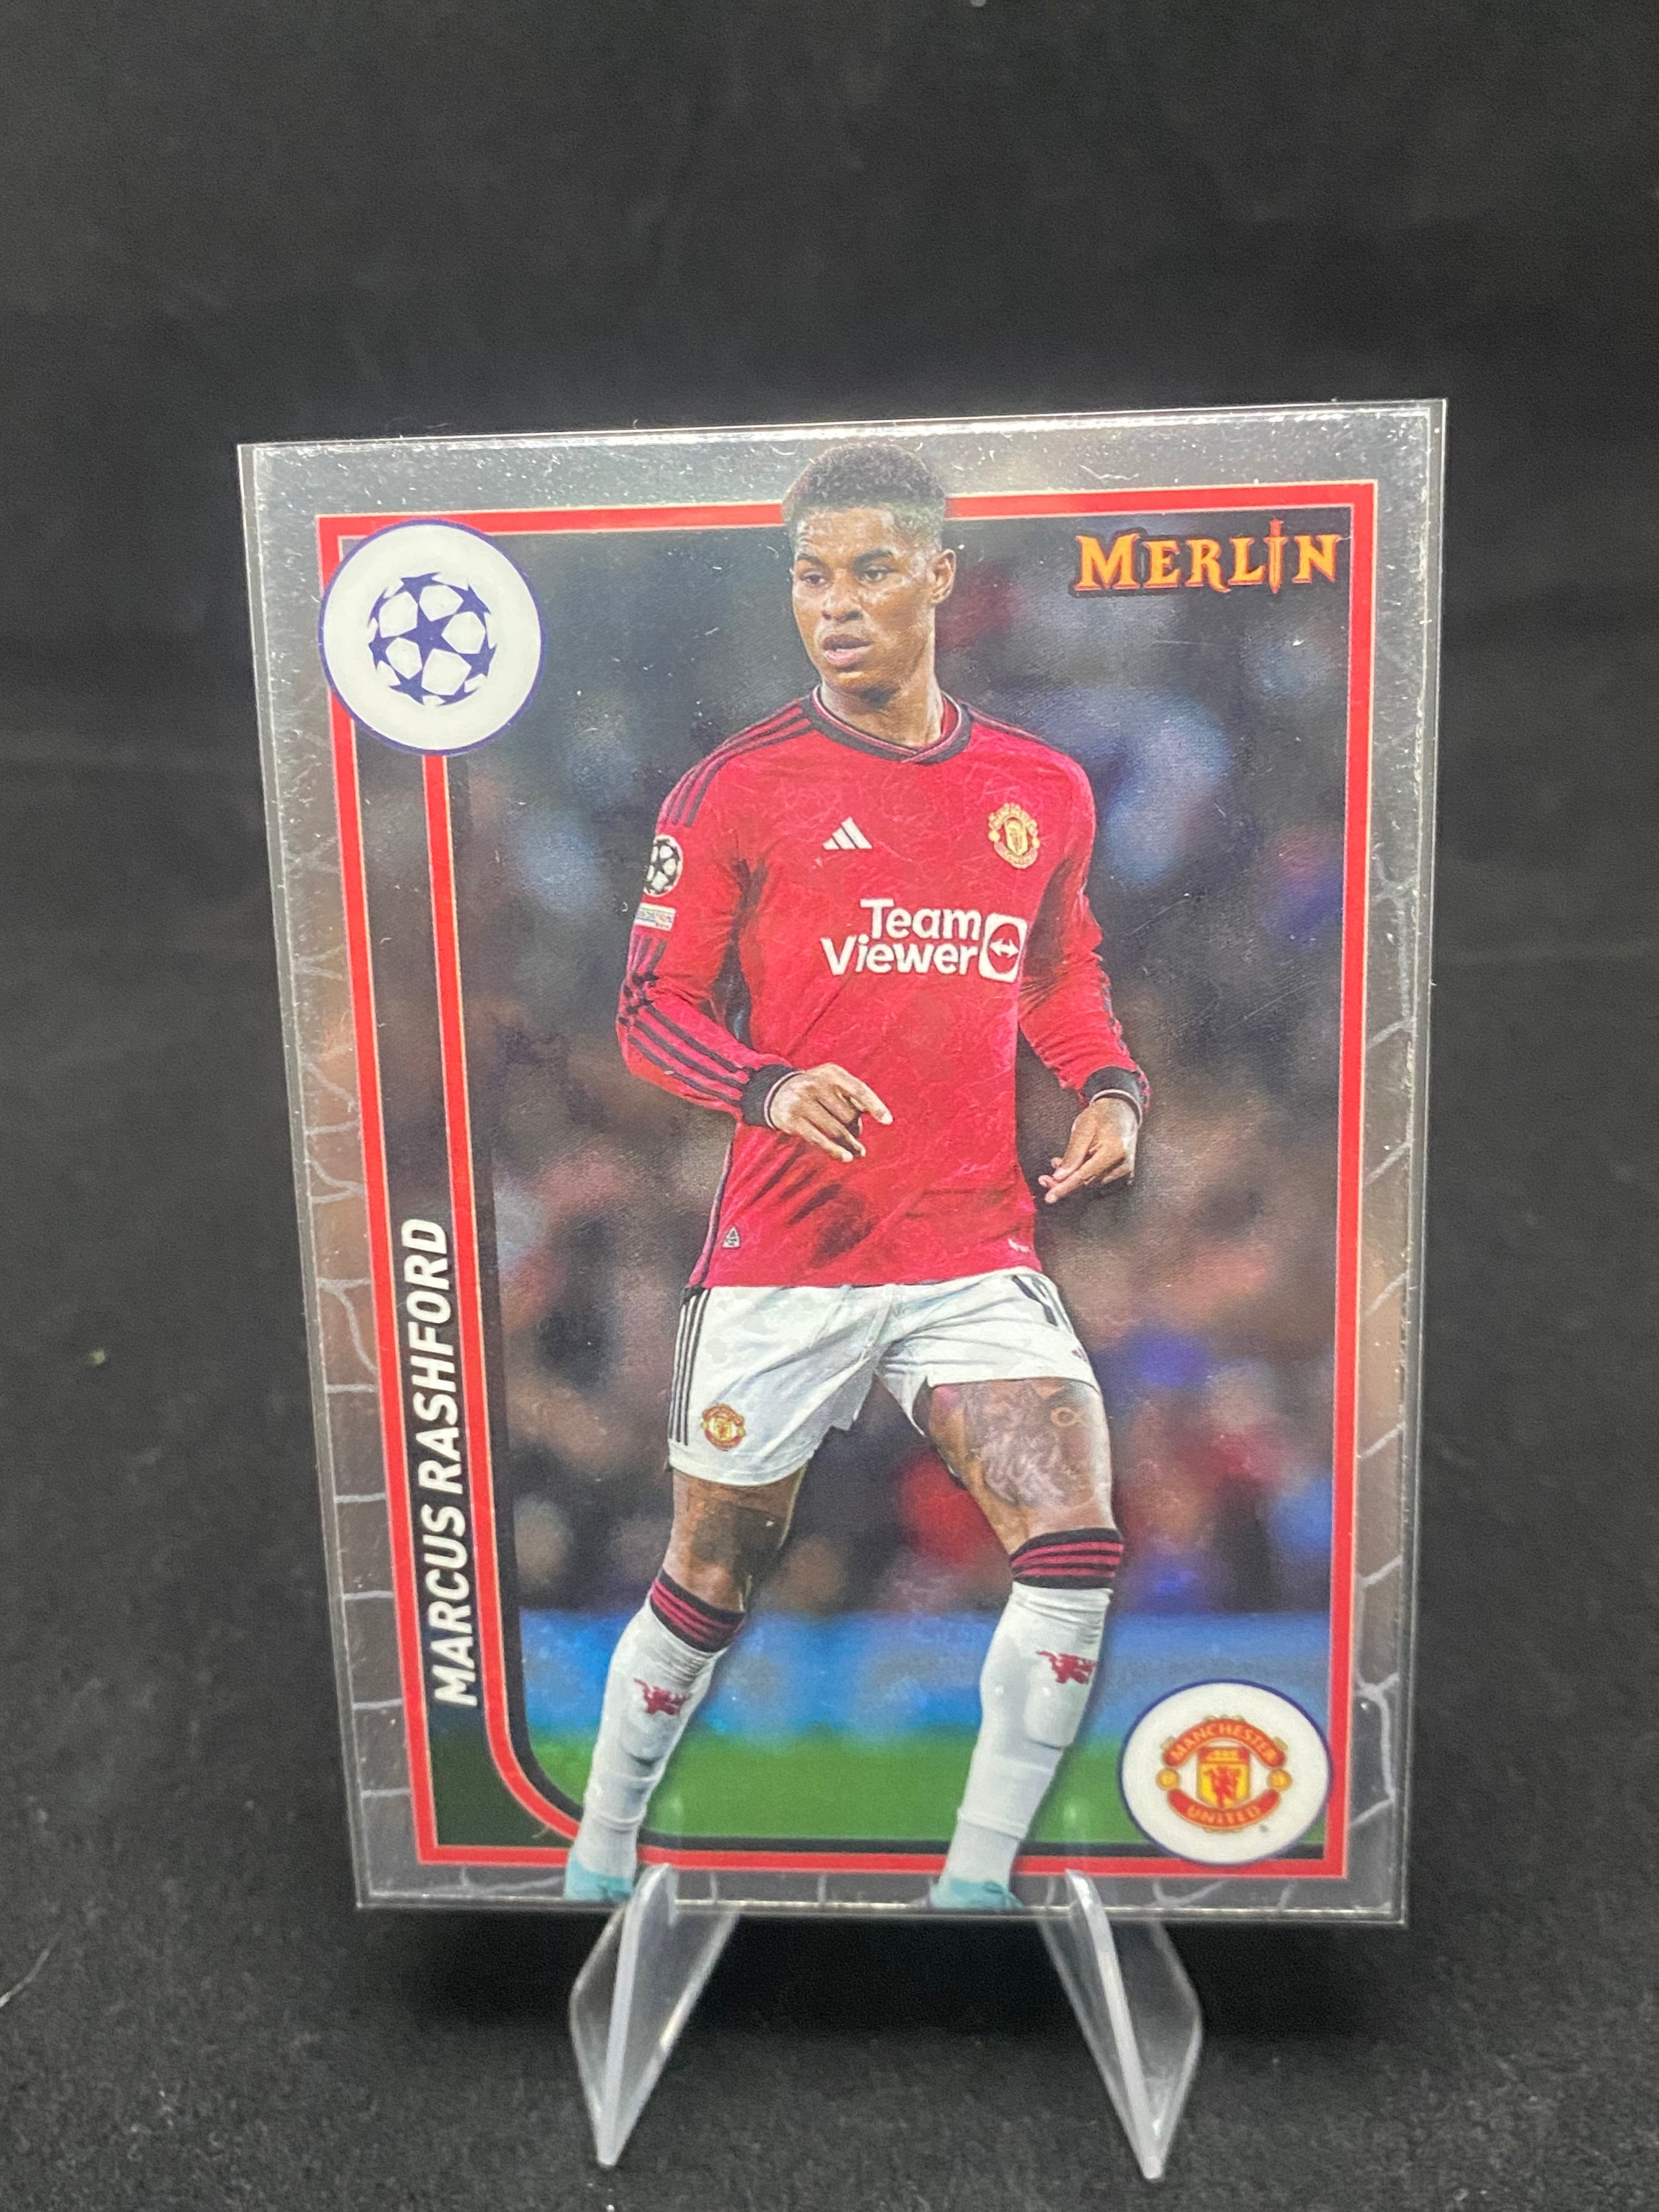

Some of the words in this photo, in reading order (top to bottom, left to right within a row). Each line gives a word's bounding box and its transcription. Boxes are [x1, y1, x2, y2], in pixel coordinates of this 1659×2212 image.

[1074, 518, 1341, 594] MERLIN
[859, 898, 982, 940] Team
[819, 933, 979, 975] Viewer
[400, 1218, 464, 1495] RASHFORD
[421, 1504, 478, 1706] MARCUS
[1170, 1723, 1277, 1761] MANCHESTER
[1187, 1806, 1262, 1825] UNITED
